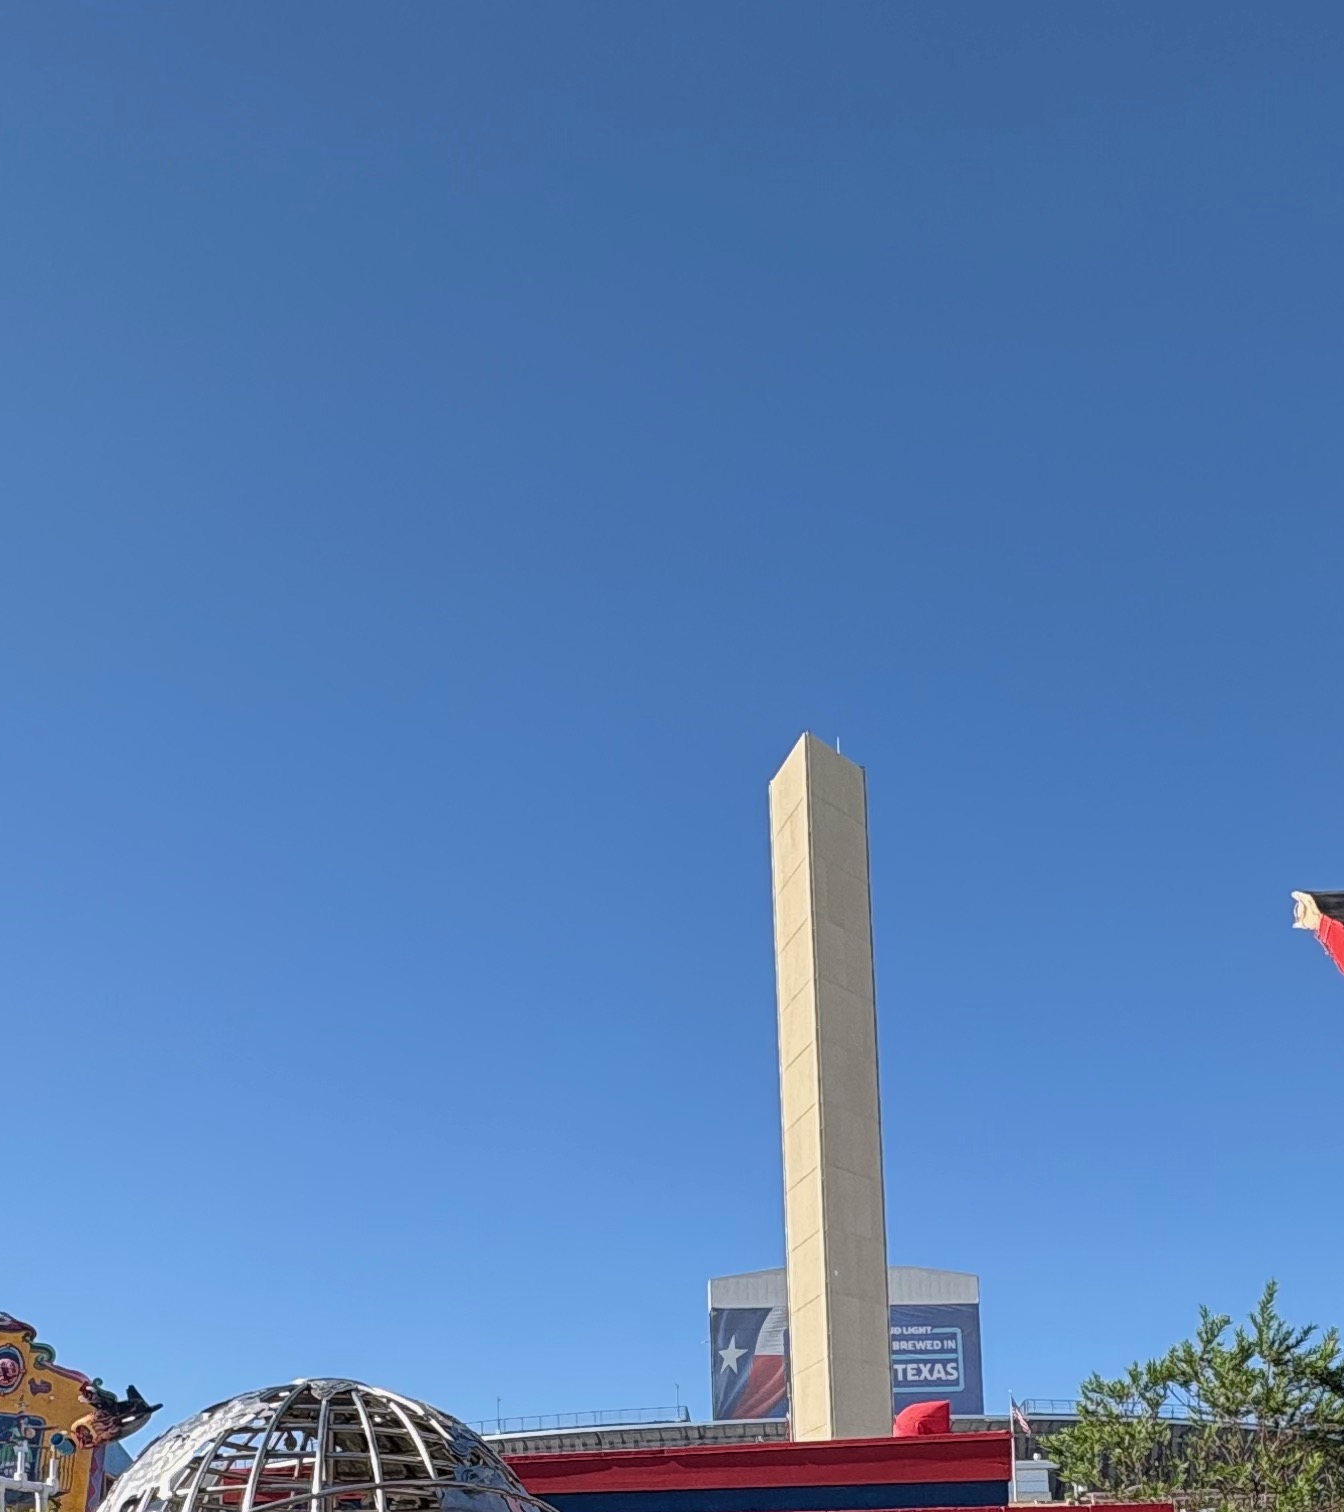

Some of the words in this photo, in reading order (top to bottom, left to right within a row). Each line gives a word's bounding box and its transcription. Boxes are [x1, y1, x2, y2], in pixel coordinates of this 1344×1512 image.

[902, 1326, 932, 1335] LIGHT
[892, 1340, 942, 1351] BREWED
[943, 1339, 956, 1350] IN
[893, 1362, 959, 1381] TEXAS
